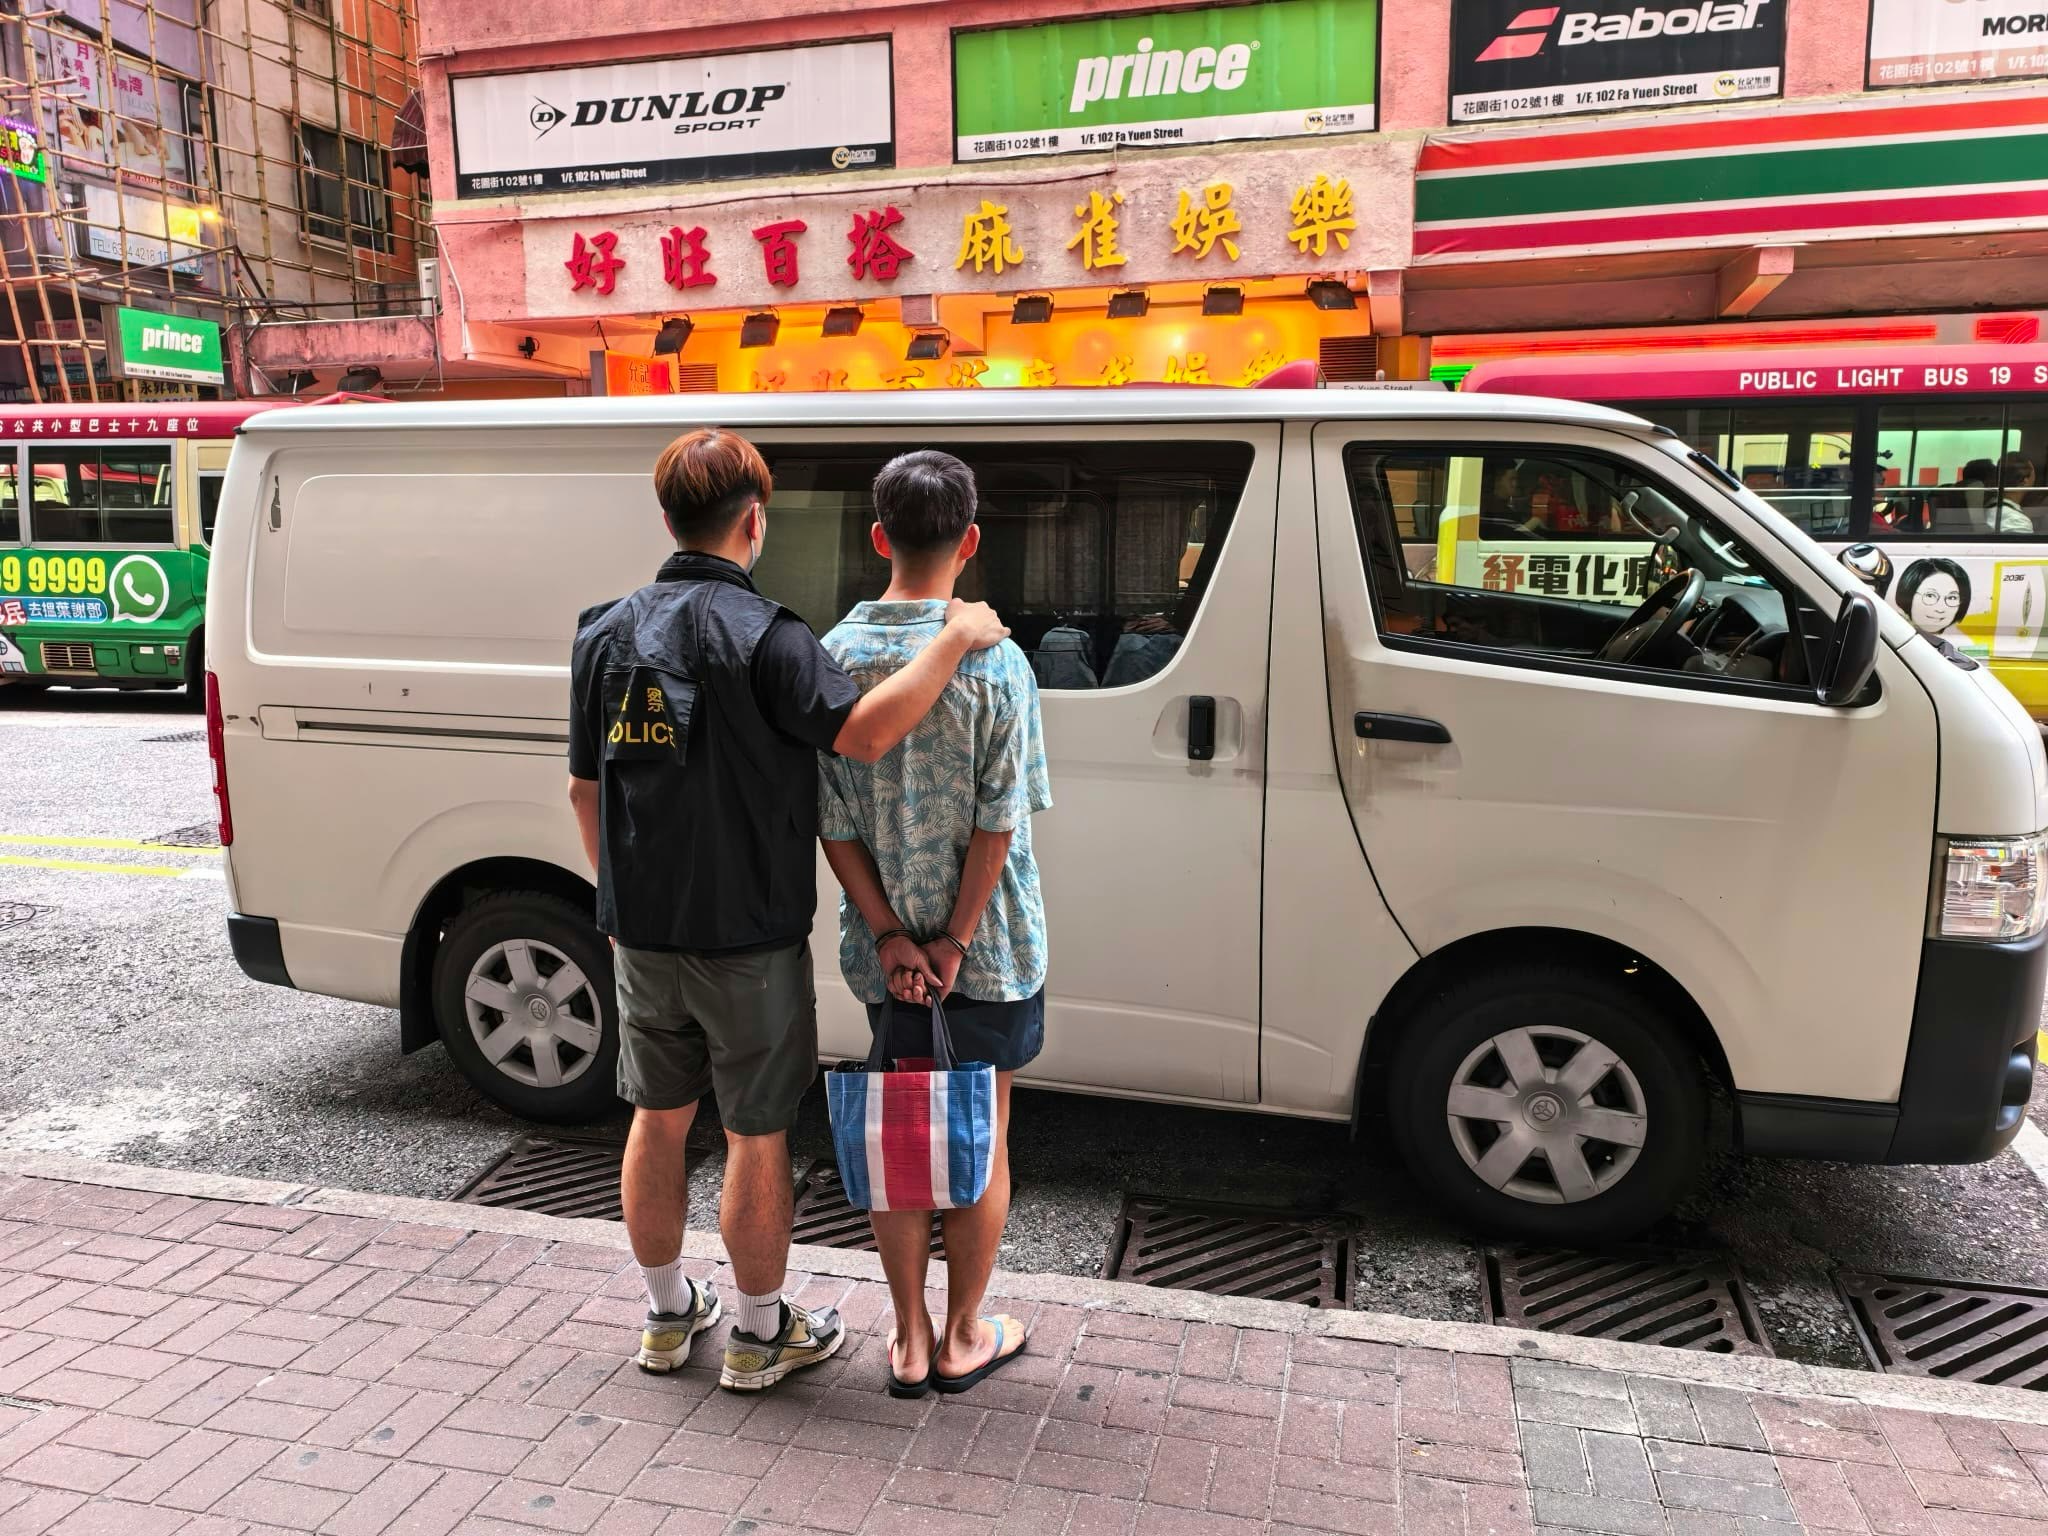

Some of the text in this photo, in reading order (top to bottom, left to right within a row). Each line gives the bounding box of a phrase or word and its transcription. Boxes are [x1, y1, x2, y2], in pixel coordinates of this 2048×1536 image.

[1558, 0, 1770, 46] Babolat
[1983, 14, 2048, 36] MOR
[1070, 37, 1251, 112] prince
[1596, 89, 1615, 102] 102
[1617, 88, 1630, 100] Fa
[1632, 86, 1660, 100] Yuen
[1662, 84, 1697, 98] Street
[571, 84, 786, 127] DUNLOP
[674, 118, 761, 134] SPORT
[1097, 132, 1113, 143] 102
[1116, 131, 1126, 142] Fa
[1128, 129, 1152, 141] Yuen
[1153, 127, 1183, 139] Street
[590, 170, 599, 181] Fa
[600, 169, 620, 180] Yuen
[621, 168, 647, 179] Street
[142, 324, 203, 354] prince
[1739, 371, 1817, 391] PUBLIC
[1837, 368, 1904, 388] LIGHT
[1924, 367, 1969, 387] BUS
[1989, 366, 2011, 385] 19
[14, 418, 199, 433] 公共小型巴士十九座位
[28, 556, 106, 594] 9999
